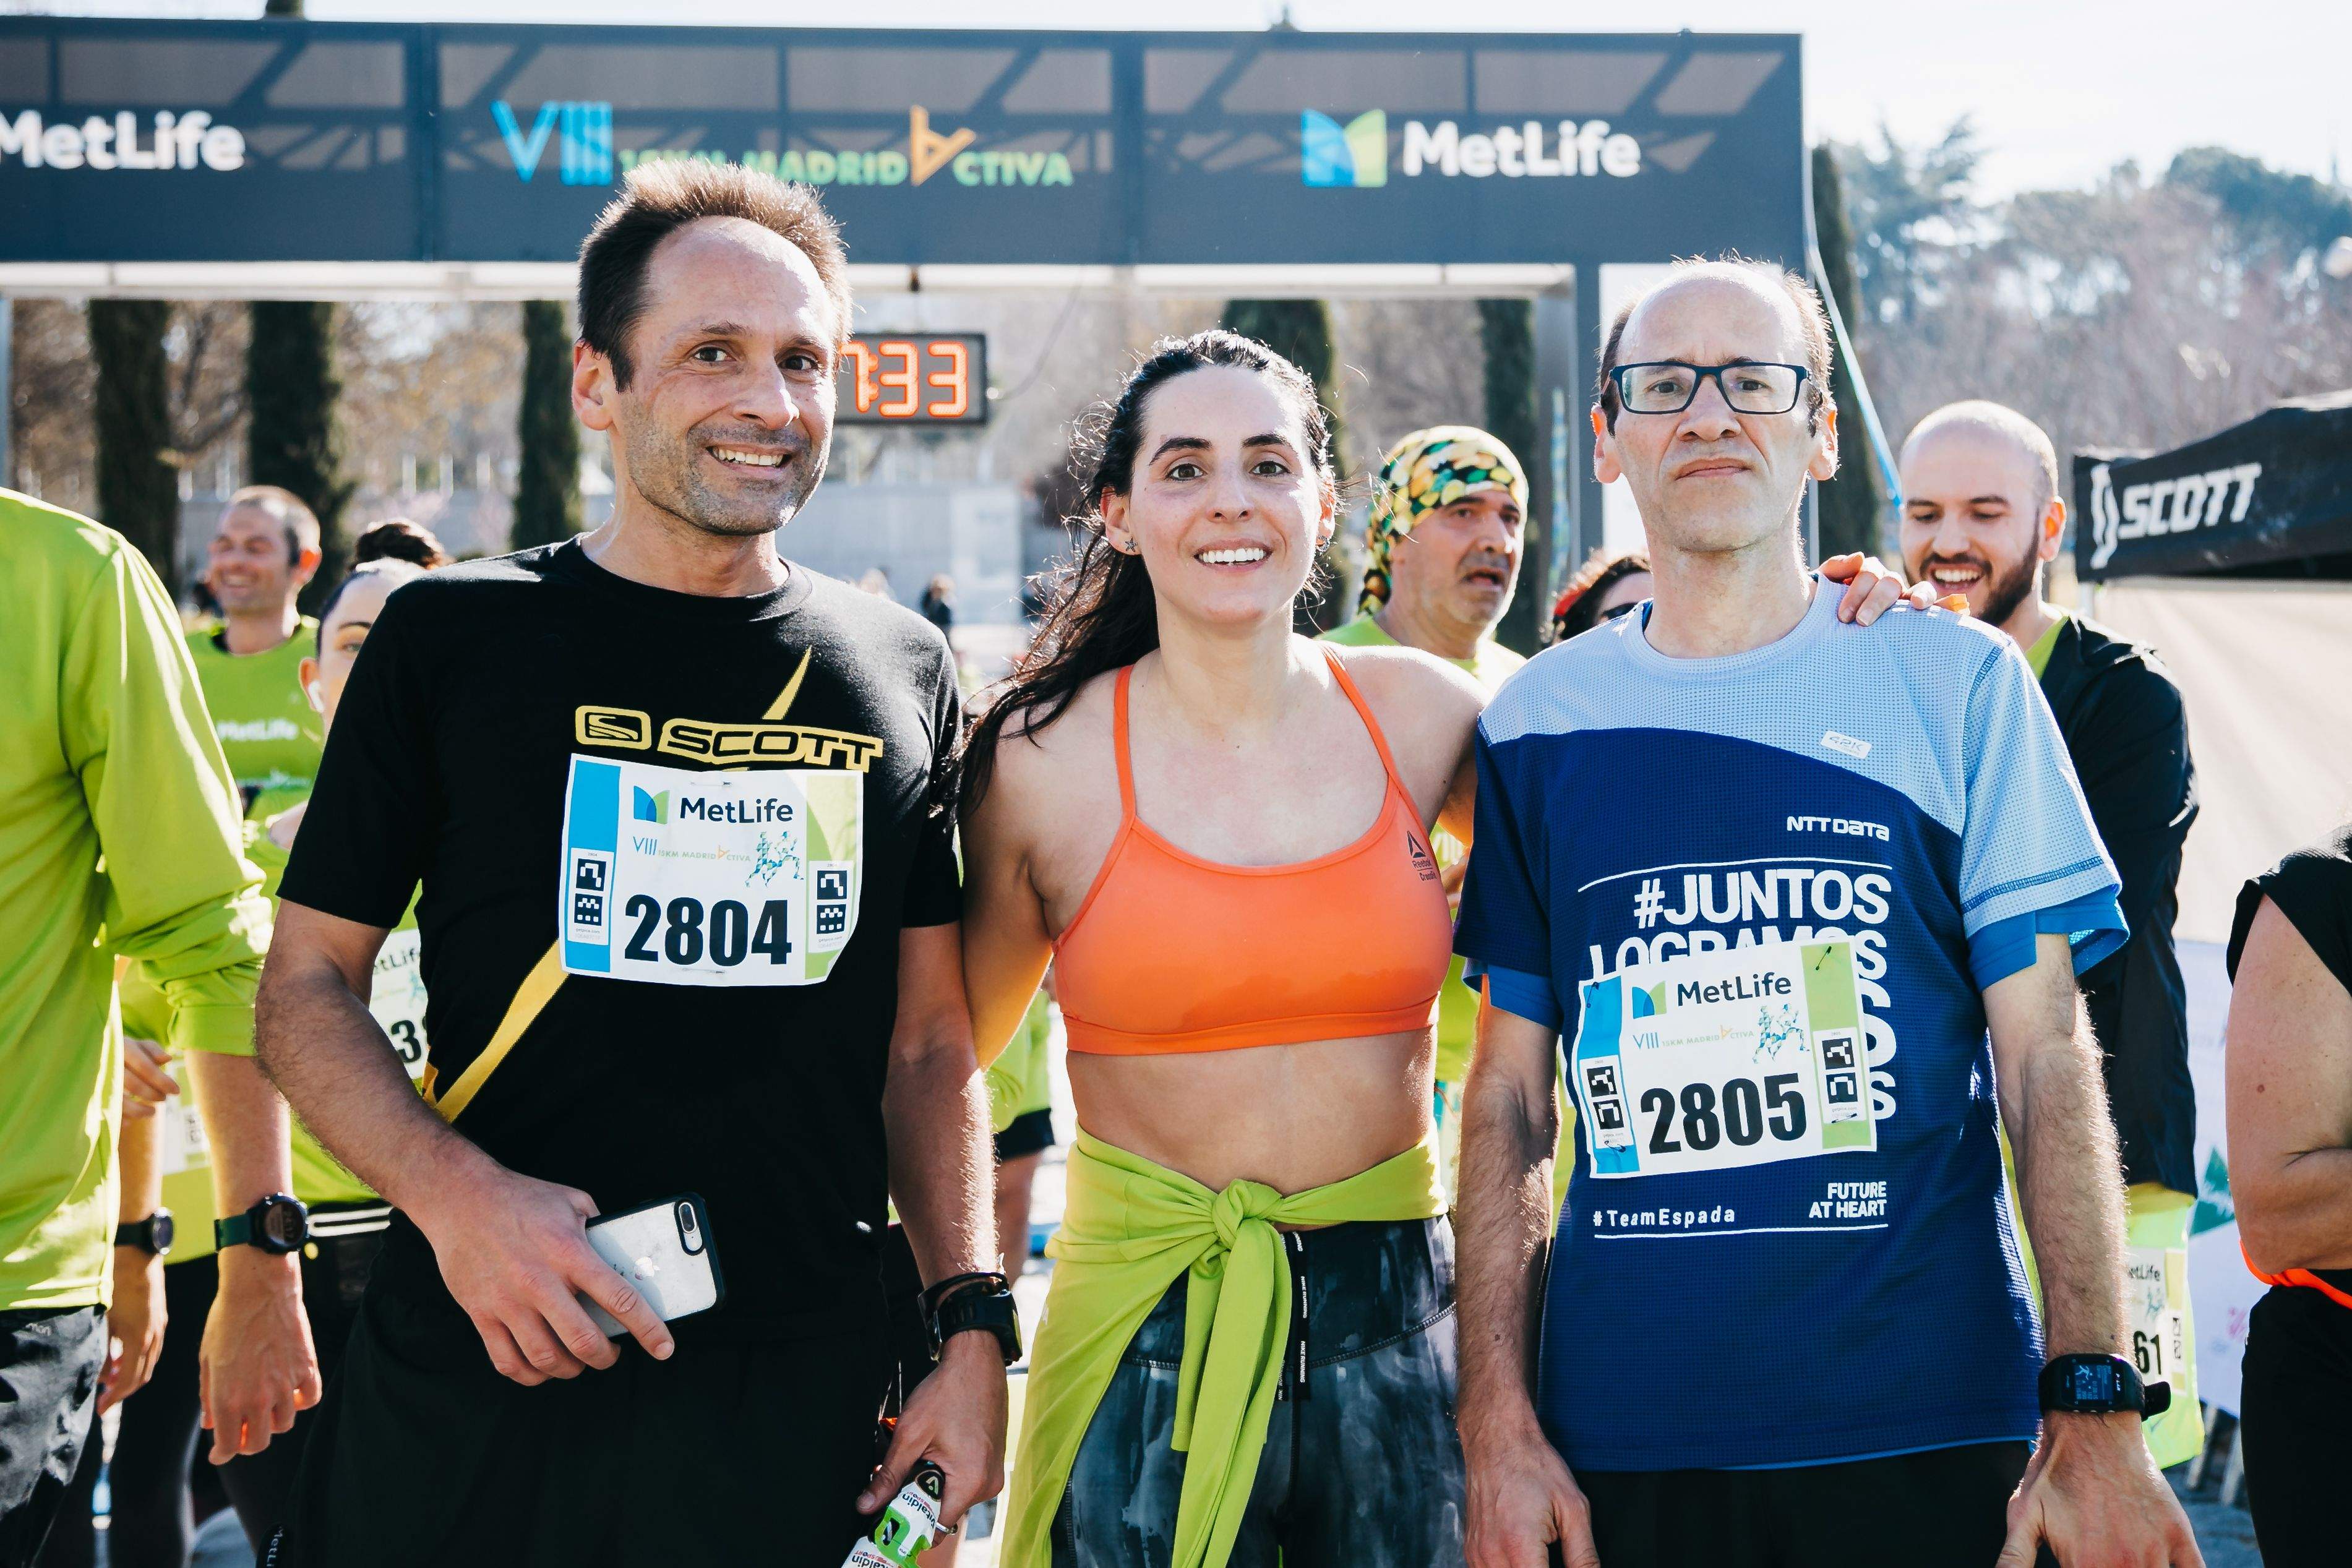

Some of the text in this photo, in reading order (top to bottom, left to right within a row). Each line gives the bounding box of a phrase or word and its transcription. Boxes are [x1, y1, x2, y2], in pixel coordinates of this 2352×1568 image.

[0, 110, 246, 171] MetLife
[1402, 119, 1642, 178] MetLife
[2118, 461, 2263, 540] SCOTT
[661, 720, 882, 769] SCOTT
[680, 797, 794, 823] MetLife
[1787, 816, 1831, 832] NTT
[632, 836, 658, 856] VIII
[658, 849, 679, 858] 15KM
[682, 851, 716, 860] MADRID
[1633, 868, 1892, 929] #JUNTOS
[624, 893, 792, 967] 2804
[1677, 971, 1792, 1007] MetLife
[1633, 1032, 1659, 1050] VIII
[1686, 1035, 1720, 1045] MADRID
[1641, 1073, 1807, 1155] 2805
[1827, 1181, 1887, 1199] FUTURE
[1593, 1205, 1735, 1228] #TeamEspada
[1809, 1199, 1887, 1219] AT HEART
[901, 1493, 936, 1530] vitaldin
